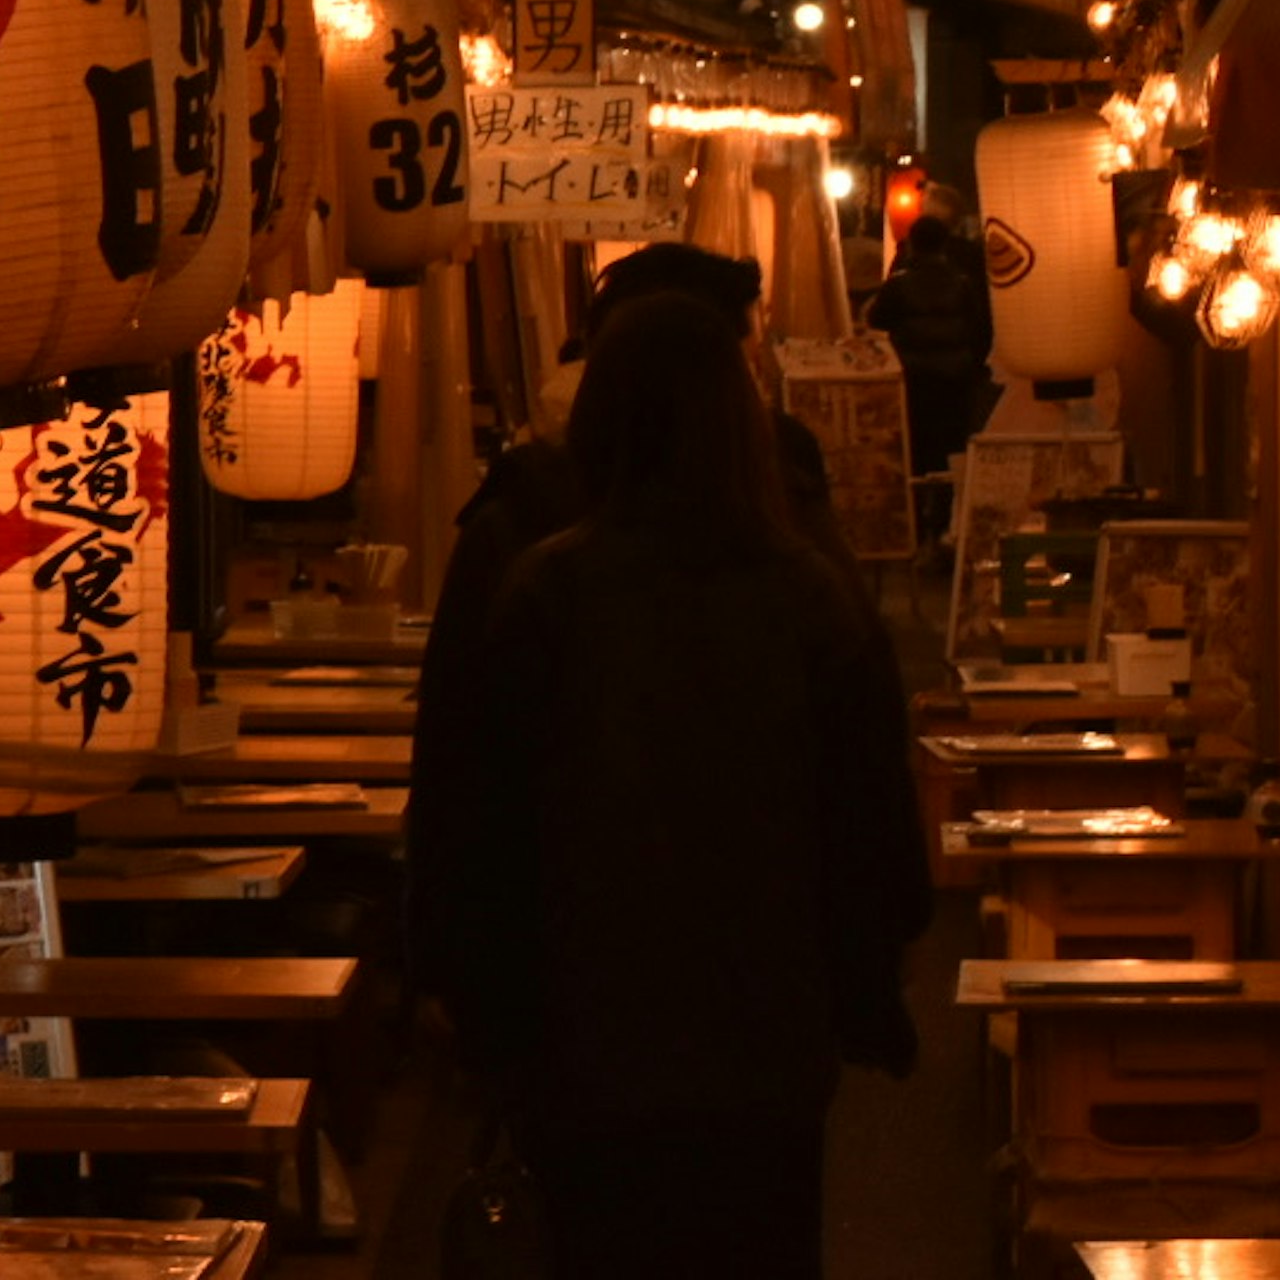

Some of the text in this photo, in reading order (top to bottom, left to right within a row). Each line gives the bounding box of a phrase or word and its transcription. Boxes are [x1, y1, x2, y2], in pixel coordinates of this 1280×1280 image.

[383, 24, 446, 105] 杉
[368, 109, 465, 212] 32
[470, 91, 636, 150] 男性用
[31, 400, 154, 750] 道食市
